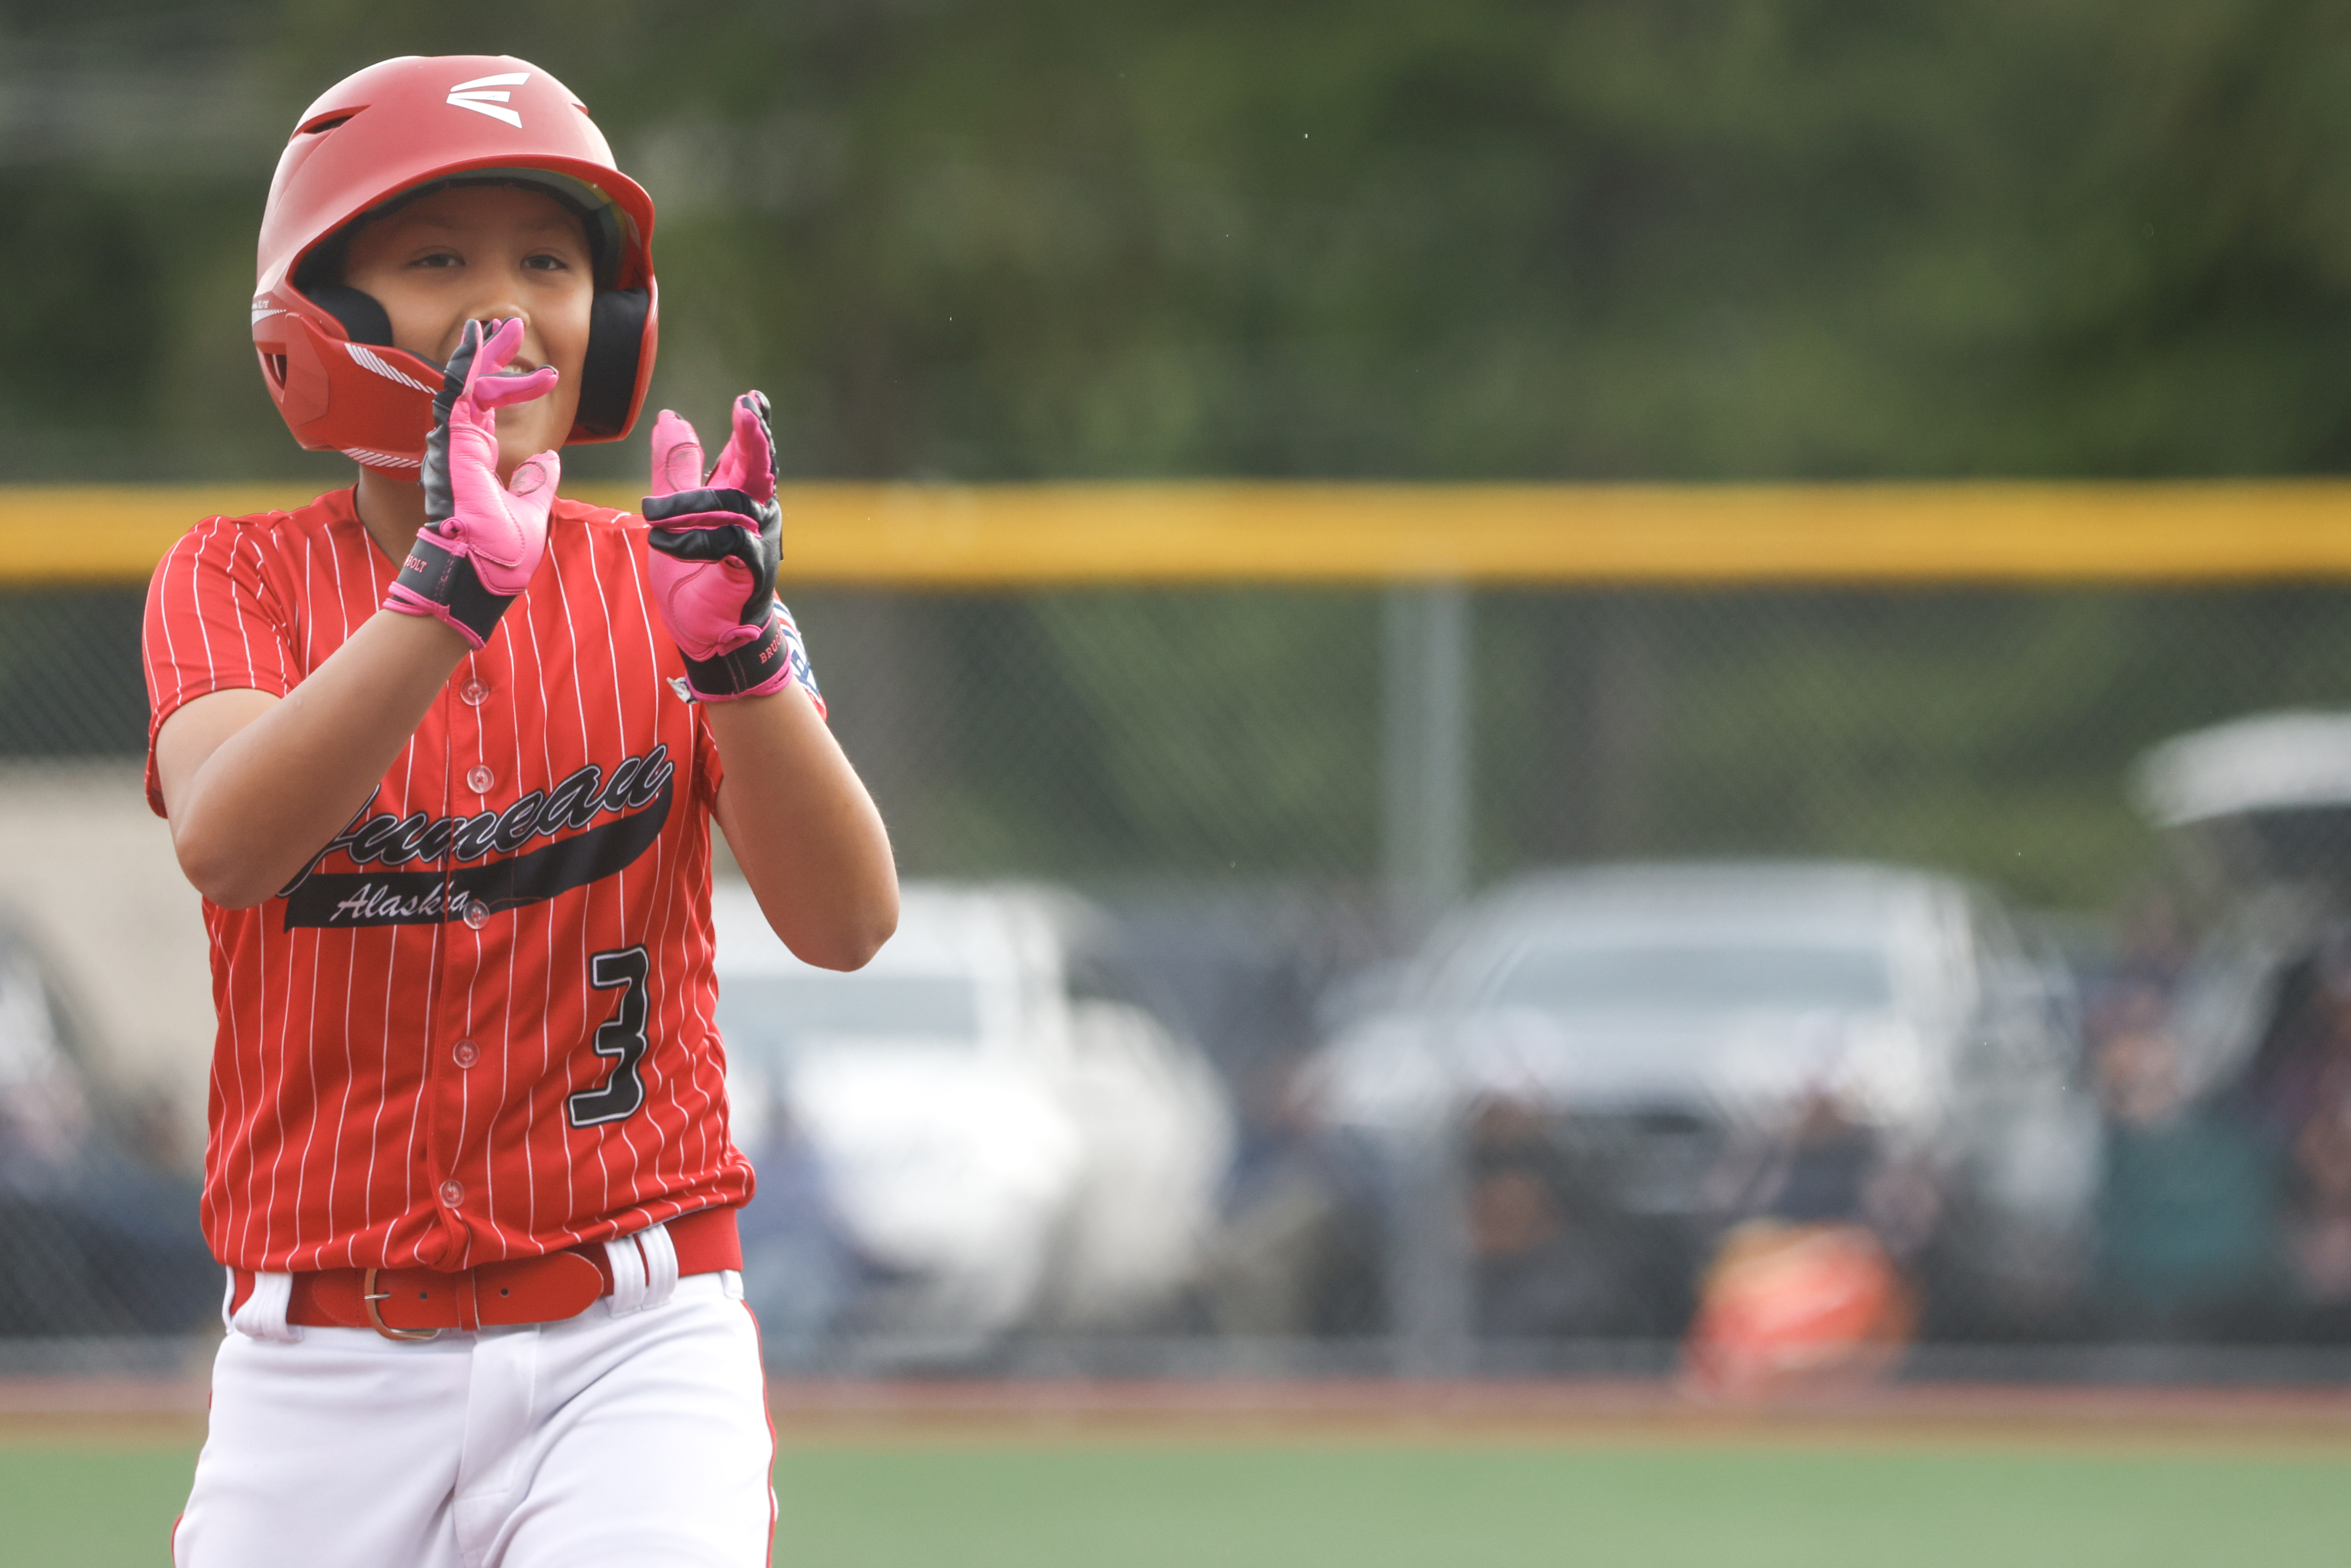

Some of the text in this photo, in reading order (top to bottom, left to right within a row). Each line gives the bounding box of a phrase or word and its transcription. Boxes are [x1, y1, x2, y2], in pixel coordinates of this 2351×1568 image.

[406, 555, 428, 573] BOLT
[329, 881, 470, 922] Alaska
[569, 942, 649, 1128] 3
